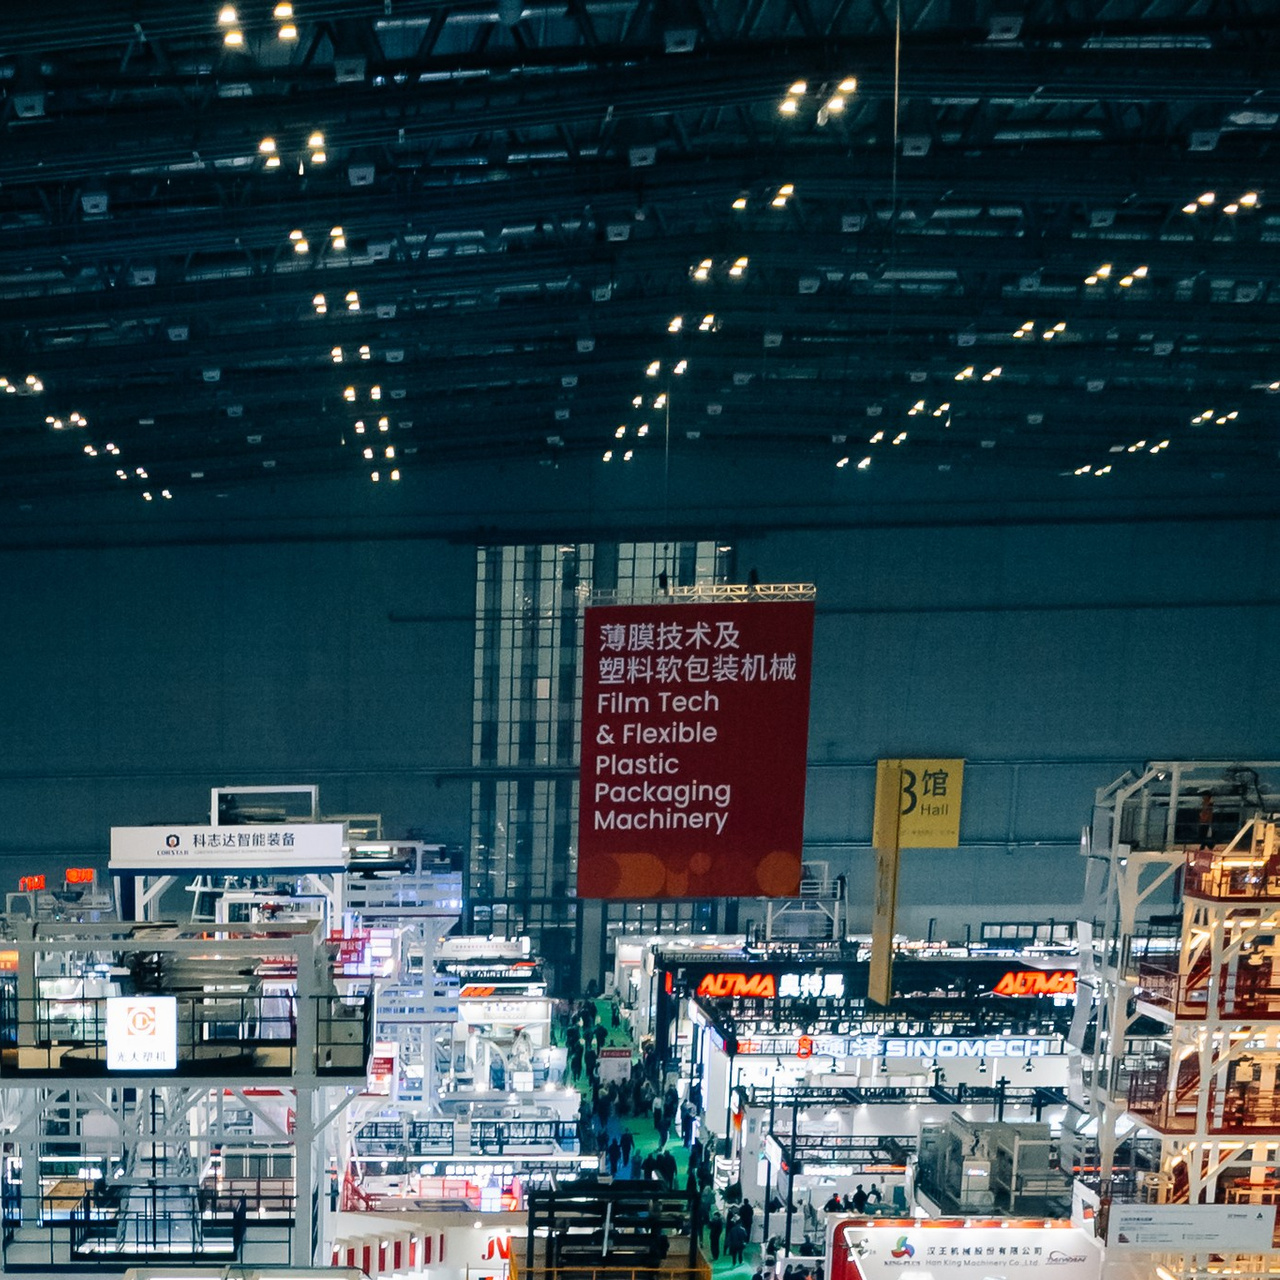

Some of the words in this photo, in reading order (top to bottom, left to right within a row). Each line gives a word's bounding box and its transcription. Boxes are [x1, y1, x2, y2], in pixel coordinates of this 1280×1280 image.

[599, 621, 740, 652] 薄膜技术及
[598, 653, 797, 685] 塑料软包装机械
[597, 691, 649, 714] Film
[658, 690, 720, 713] Tech
[596, 724, 615, 745] &
[622, 721, 718, 744] Flexible
[595, 753, 680, 775] Plastic
[595, 780, 731, 808] Packaging
[922, 769, 949, 797] 馆
[594, 808, 729, 835] Machinery
[921, 803, 949, 816] Hall
[192, 832, 296, 848] 科志达智能装备
[697, 973, 776, 997] ALTMA
[992, 970, 1077, 995] ALTMA
[926, 1246, 1042, 1257] 汉王机械股份有限公司
[942, 1259, 962, 1268] King
[963, 1259, 1007, 1268] Machinery
